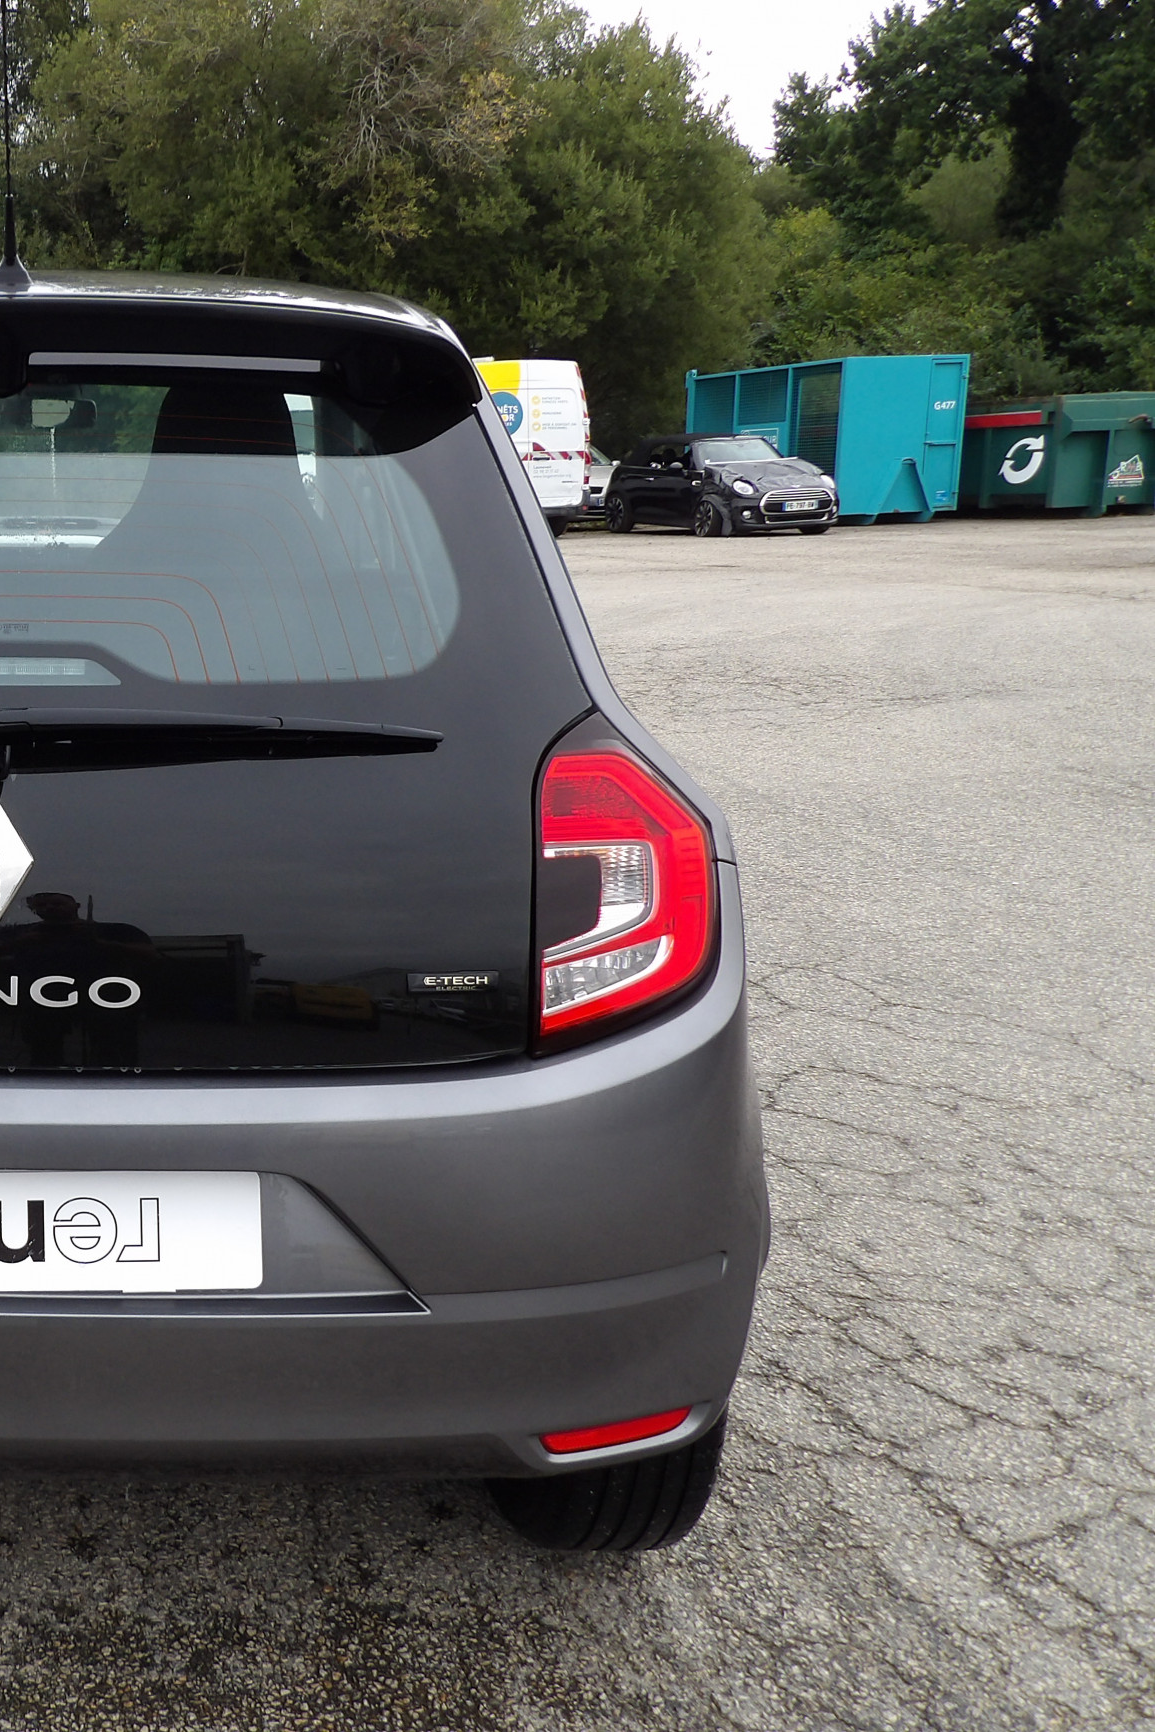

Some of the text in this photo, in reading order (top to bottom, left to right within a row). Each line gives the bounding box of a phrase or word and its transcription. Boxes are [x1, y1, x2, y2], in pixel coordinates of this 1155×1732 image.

[496, 403, 519, 414] NÊTS
[934, 400, 956, 410] G477
[424, 976, 488, 986] E-TECH
